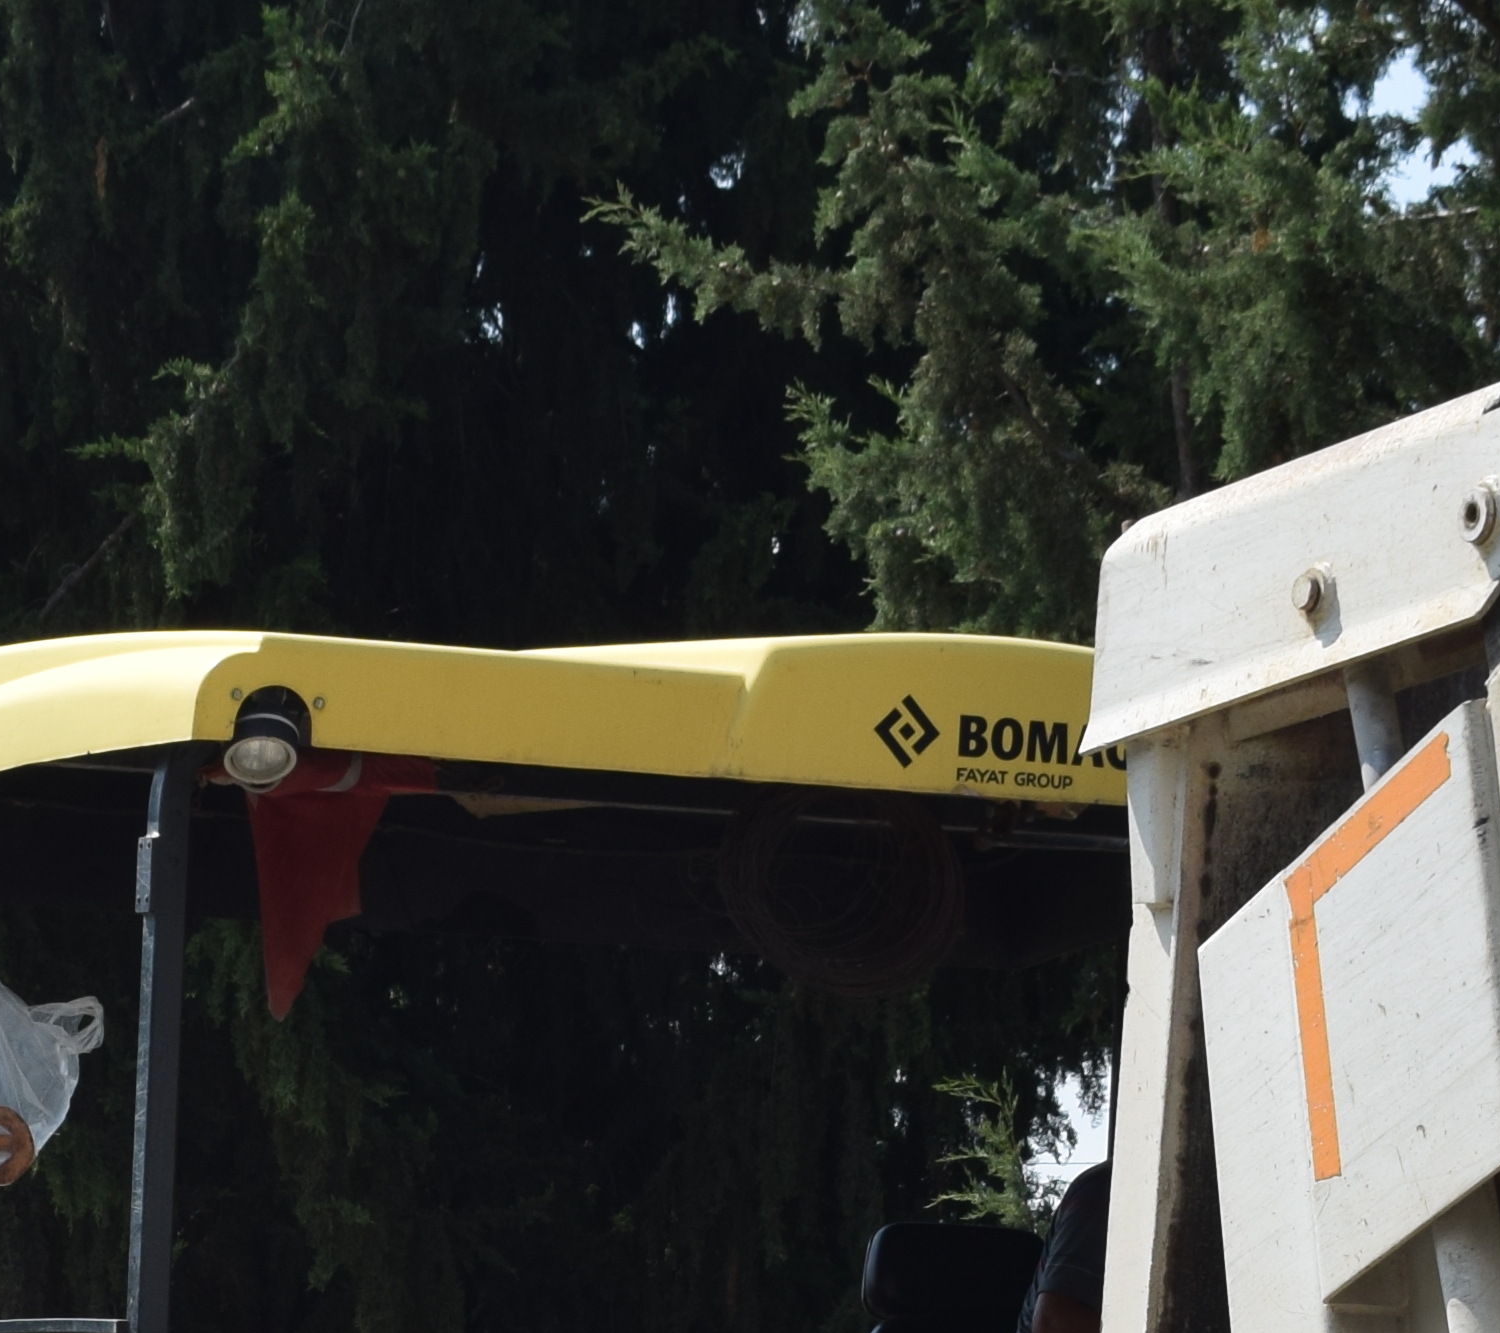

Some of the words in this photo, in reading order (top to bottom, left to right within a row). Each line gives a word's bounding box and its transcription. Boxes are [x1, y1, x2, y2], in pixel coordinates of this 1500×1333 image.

[958, 715, 1127, 771] BOMA
[956, 767, 1009, 785] FAYAT
[1014, 772, 1073, 790] GROUP
